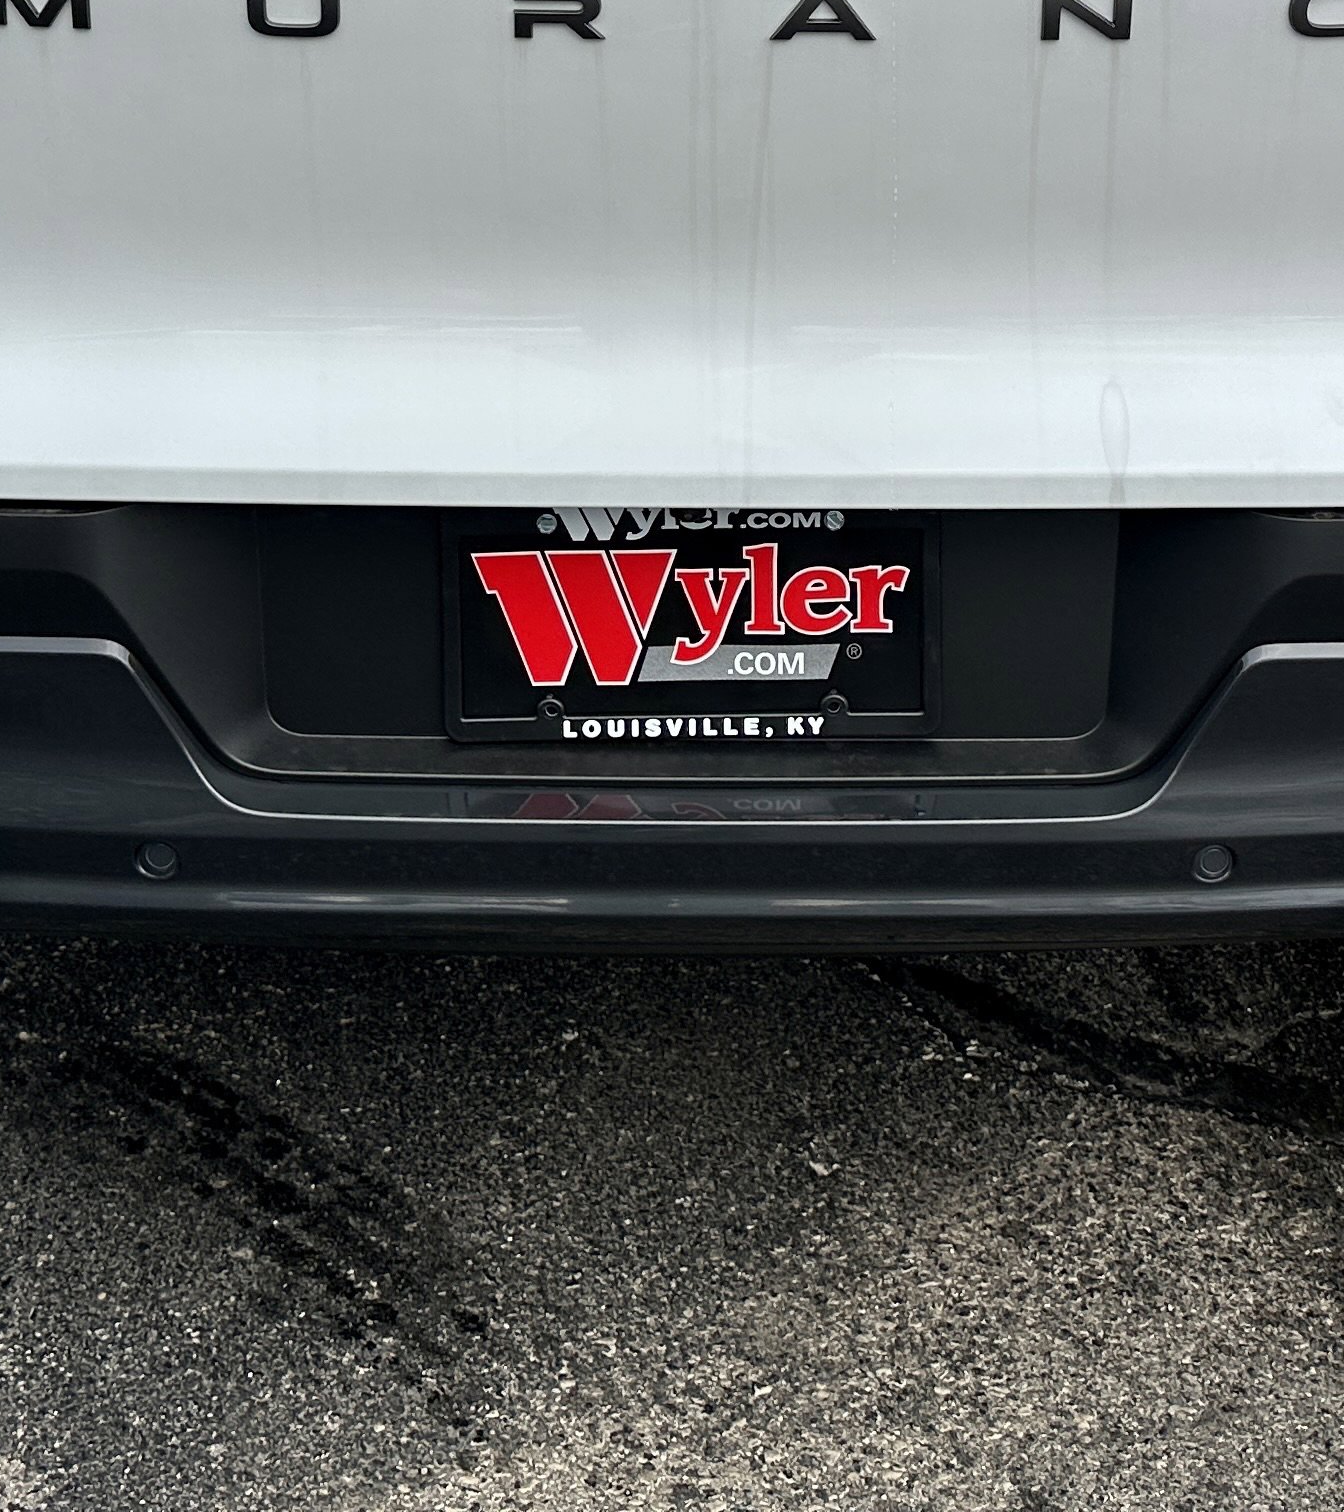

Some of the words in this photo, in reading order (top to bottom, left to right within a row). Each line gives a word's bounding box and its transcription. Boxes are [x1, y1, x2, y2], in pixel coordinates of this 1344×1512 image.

[471, 543, 910, 686] Wyler
[727, 652, 805, 675] .COM
[563, 717, 773, 739] LOUISVILLE,
[787, 716, 825, 736] KY
